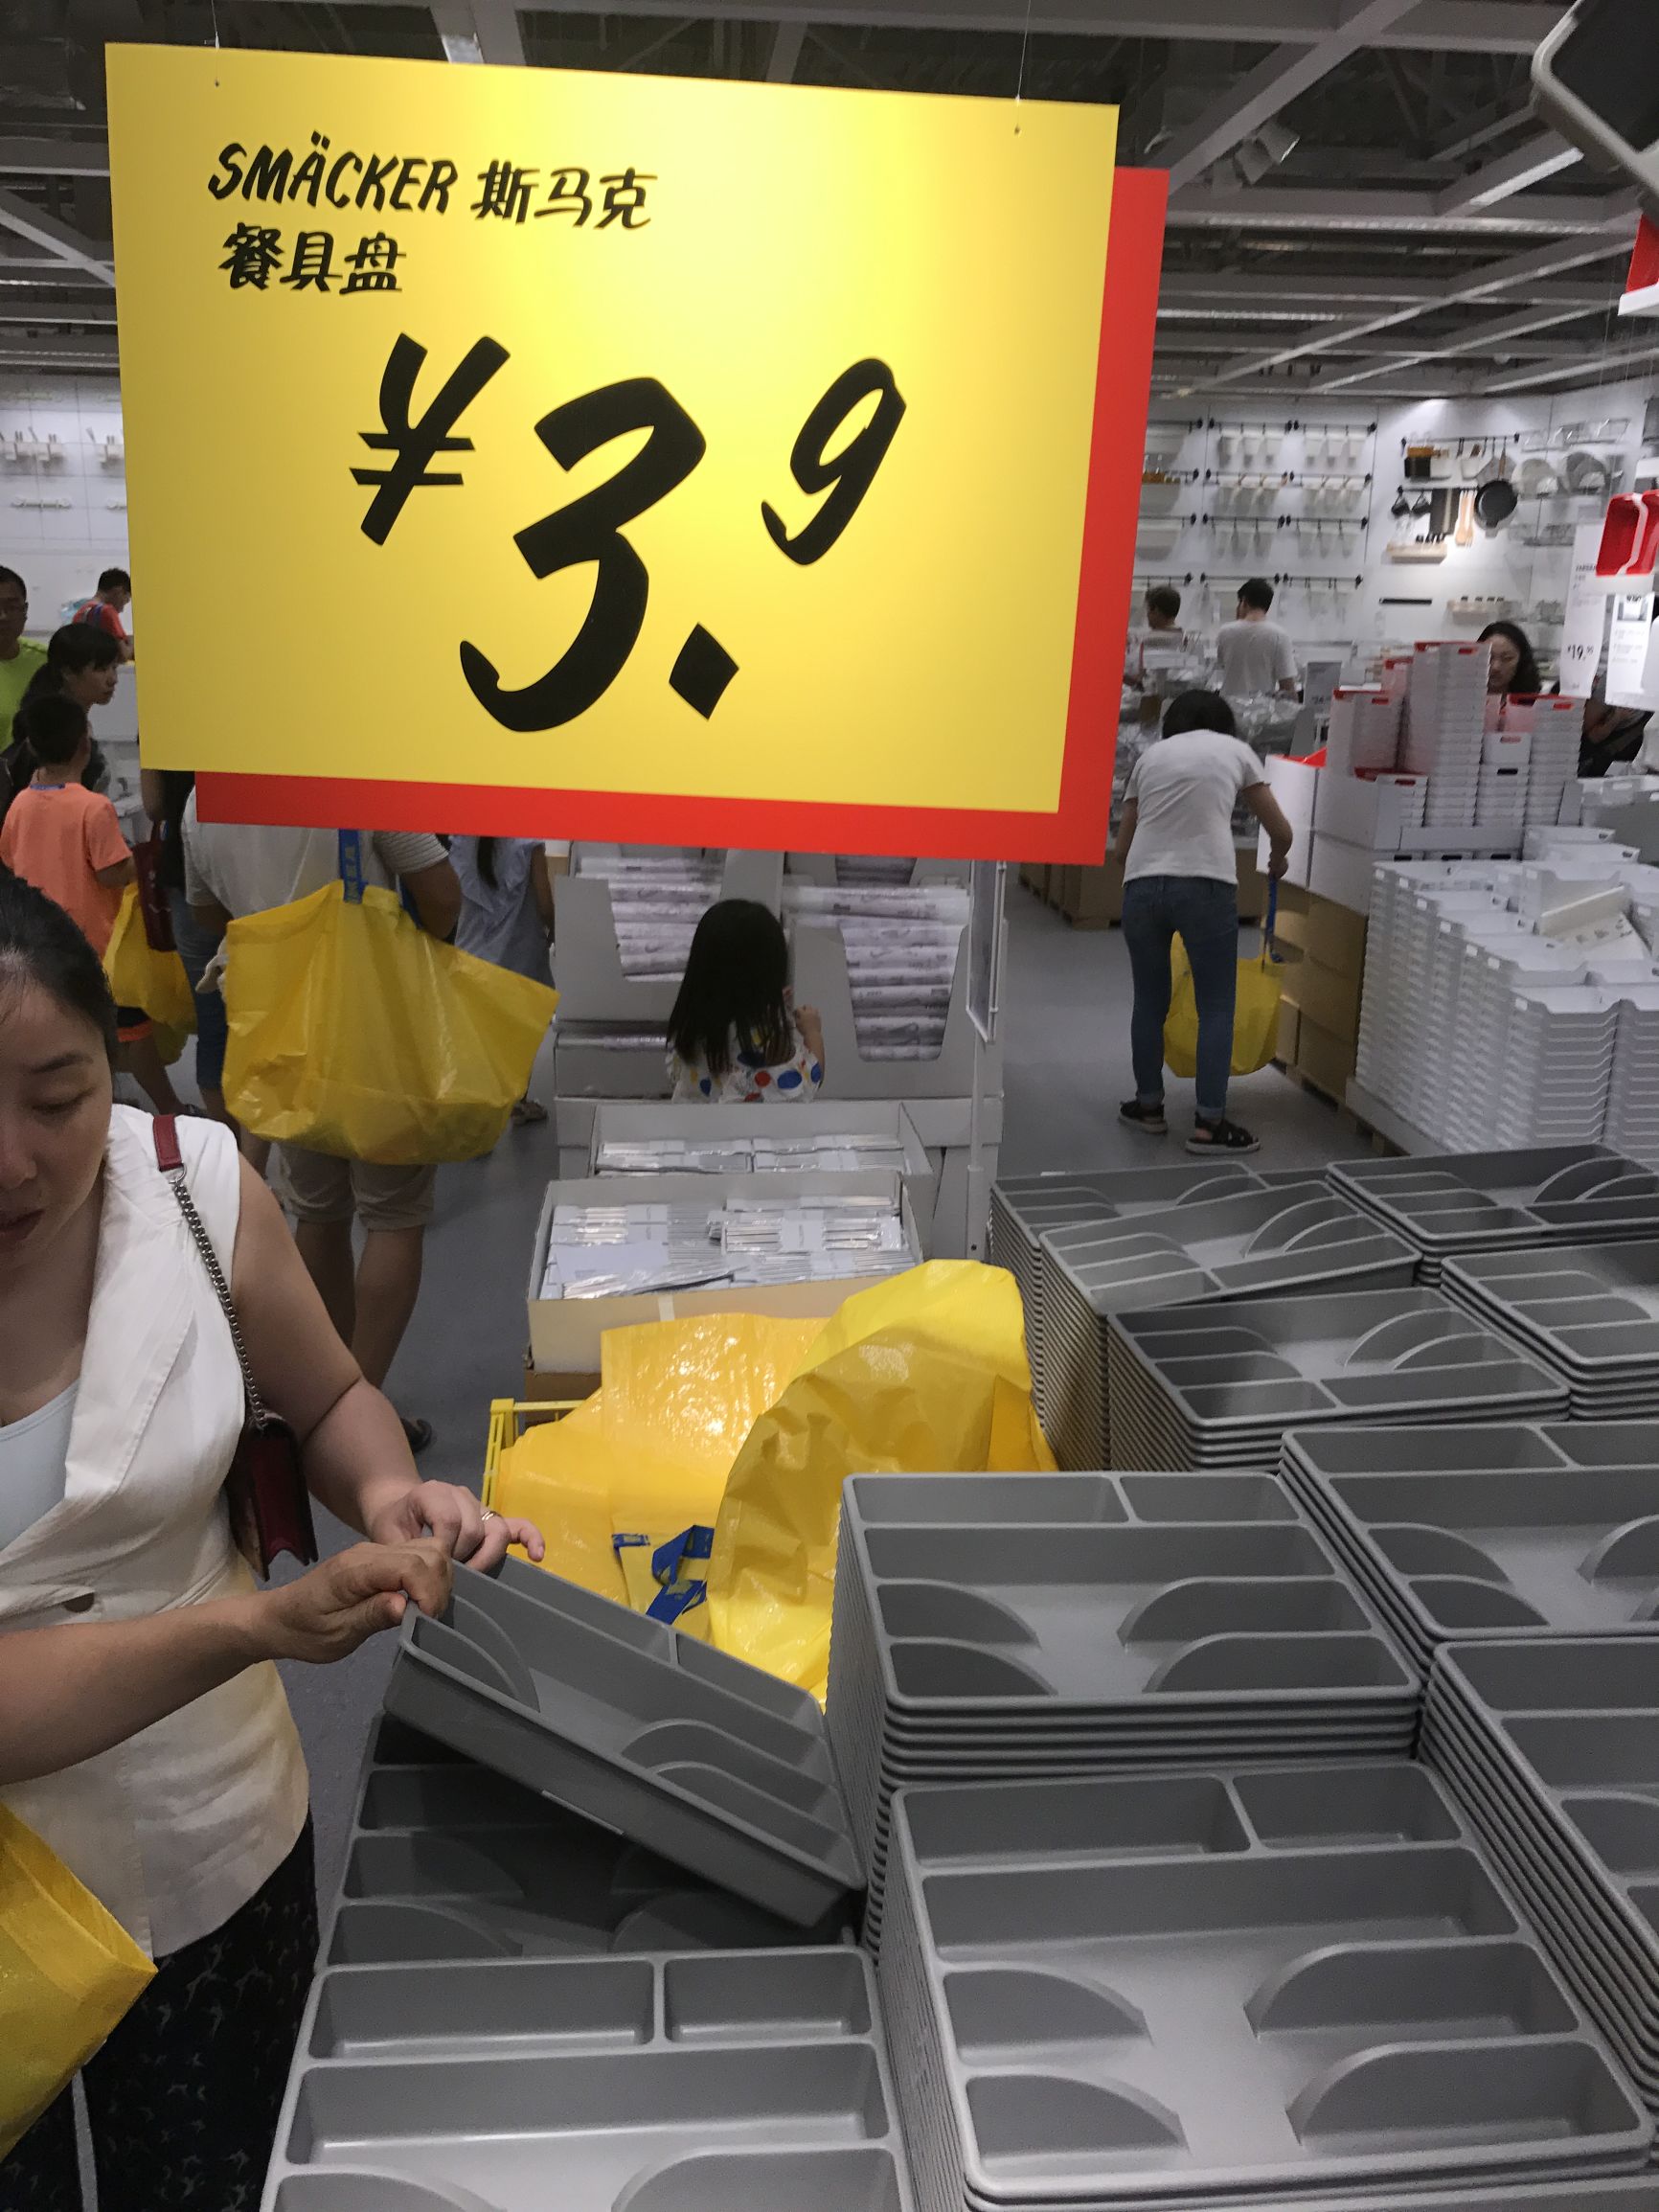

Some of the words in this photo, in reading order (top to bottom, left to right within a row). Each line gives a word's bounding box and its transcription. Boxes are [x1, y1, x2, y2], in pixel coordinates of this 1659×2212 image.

[207, 129, 459, 215] SMÄCKER
[469, 159, 658, 230] 斯马克
[217, 221, 407, 296] 餐具盘
[350, 331, 907, 732] ¥3.9
